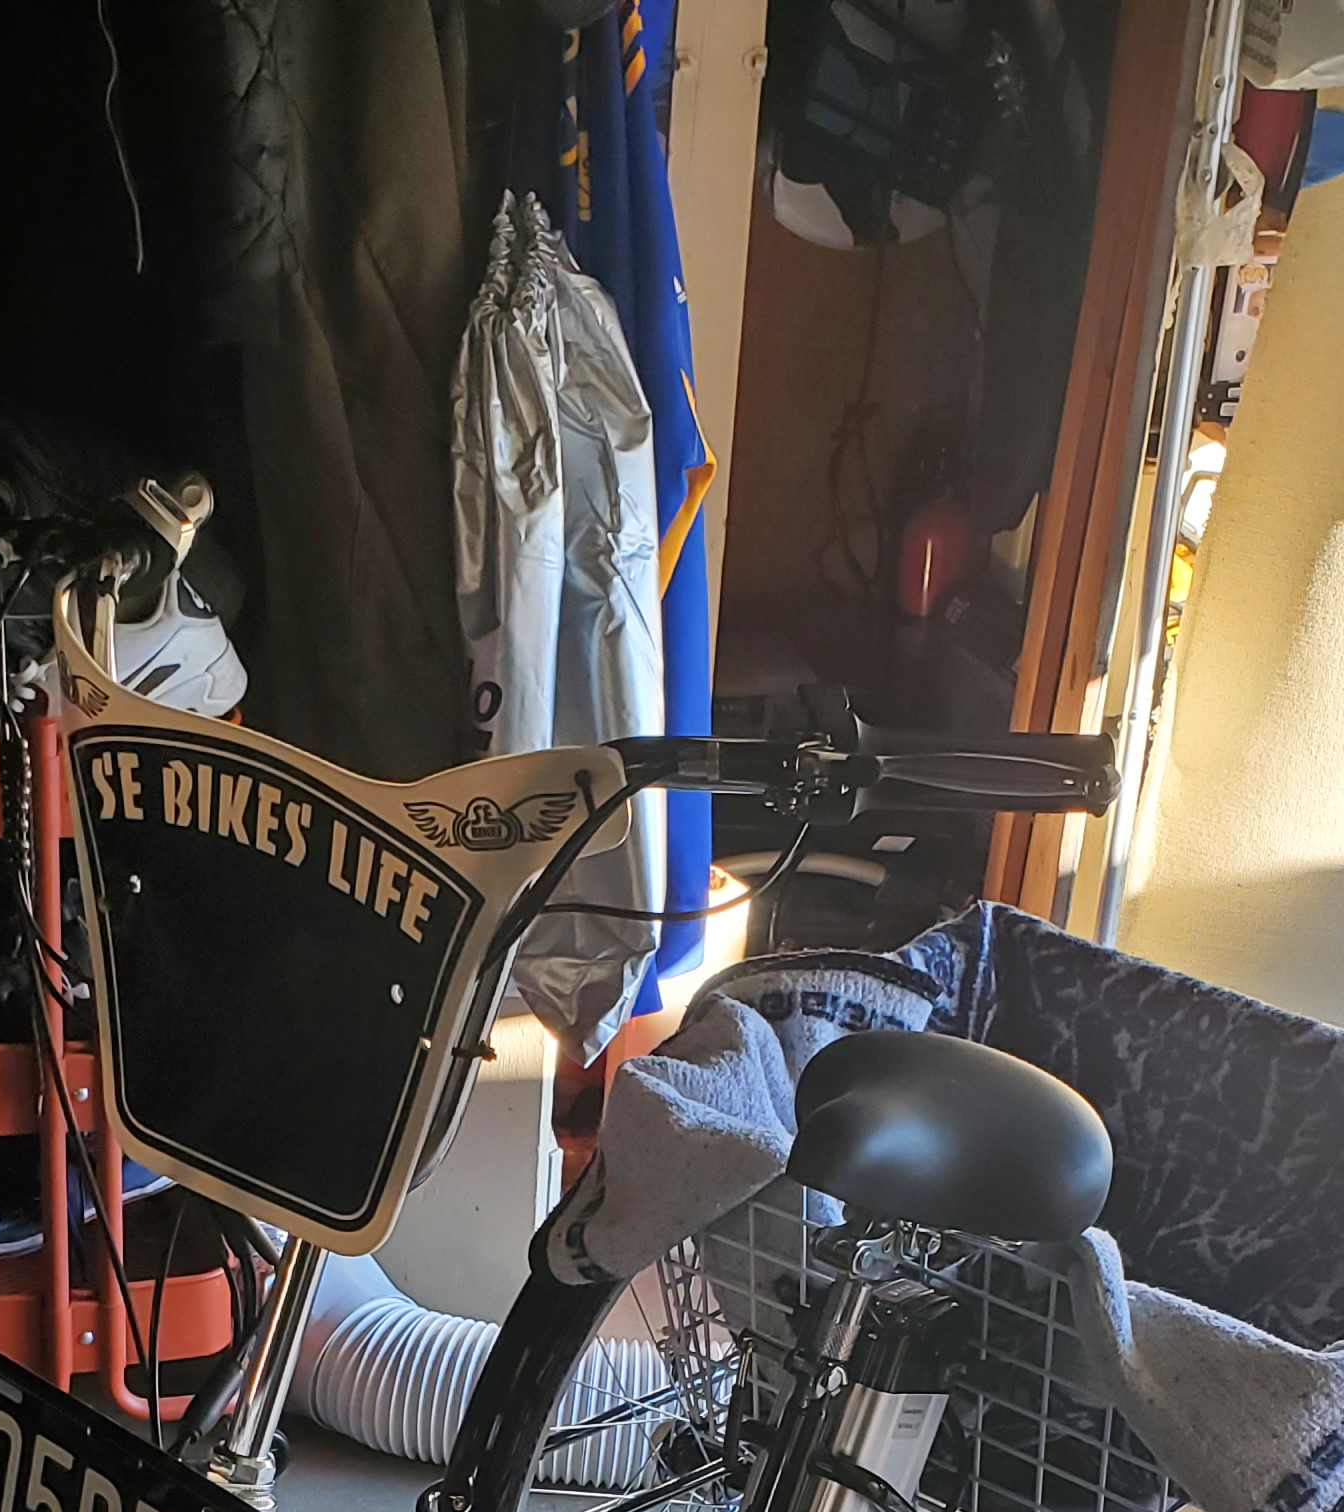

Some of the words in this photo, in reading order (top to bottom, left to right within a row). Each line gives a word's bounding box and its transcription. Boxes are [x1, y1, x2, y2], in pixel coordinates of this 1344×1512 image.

[92, 751, 144, 820] SE
[162, 760, 313, 867] BIKES
[328, 819, 440, 944] LIFE
